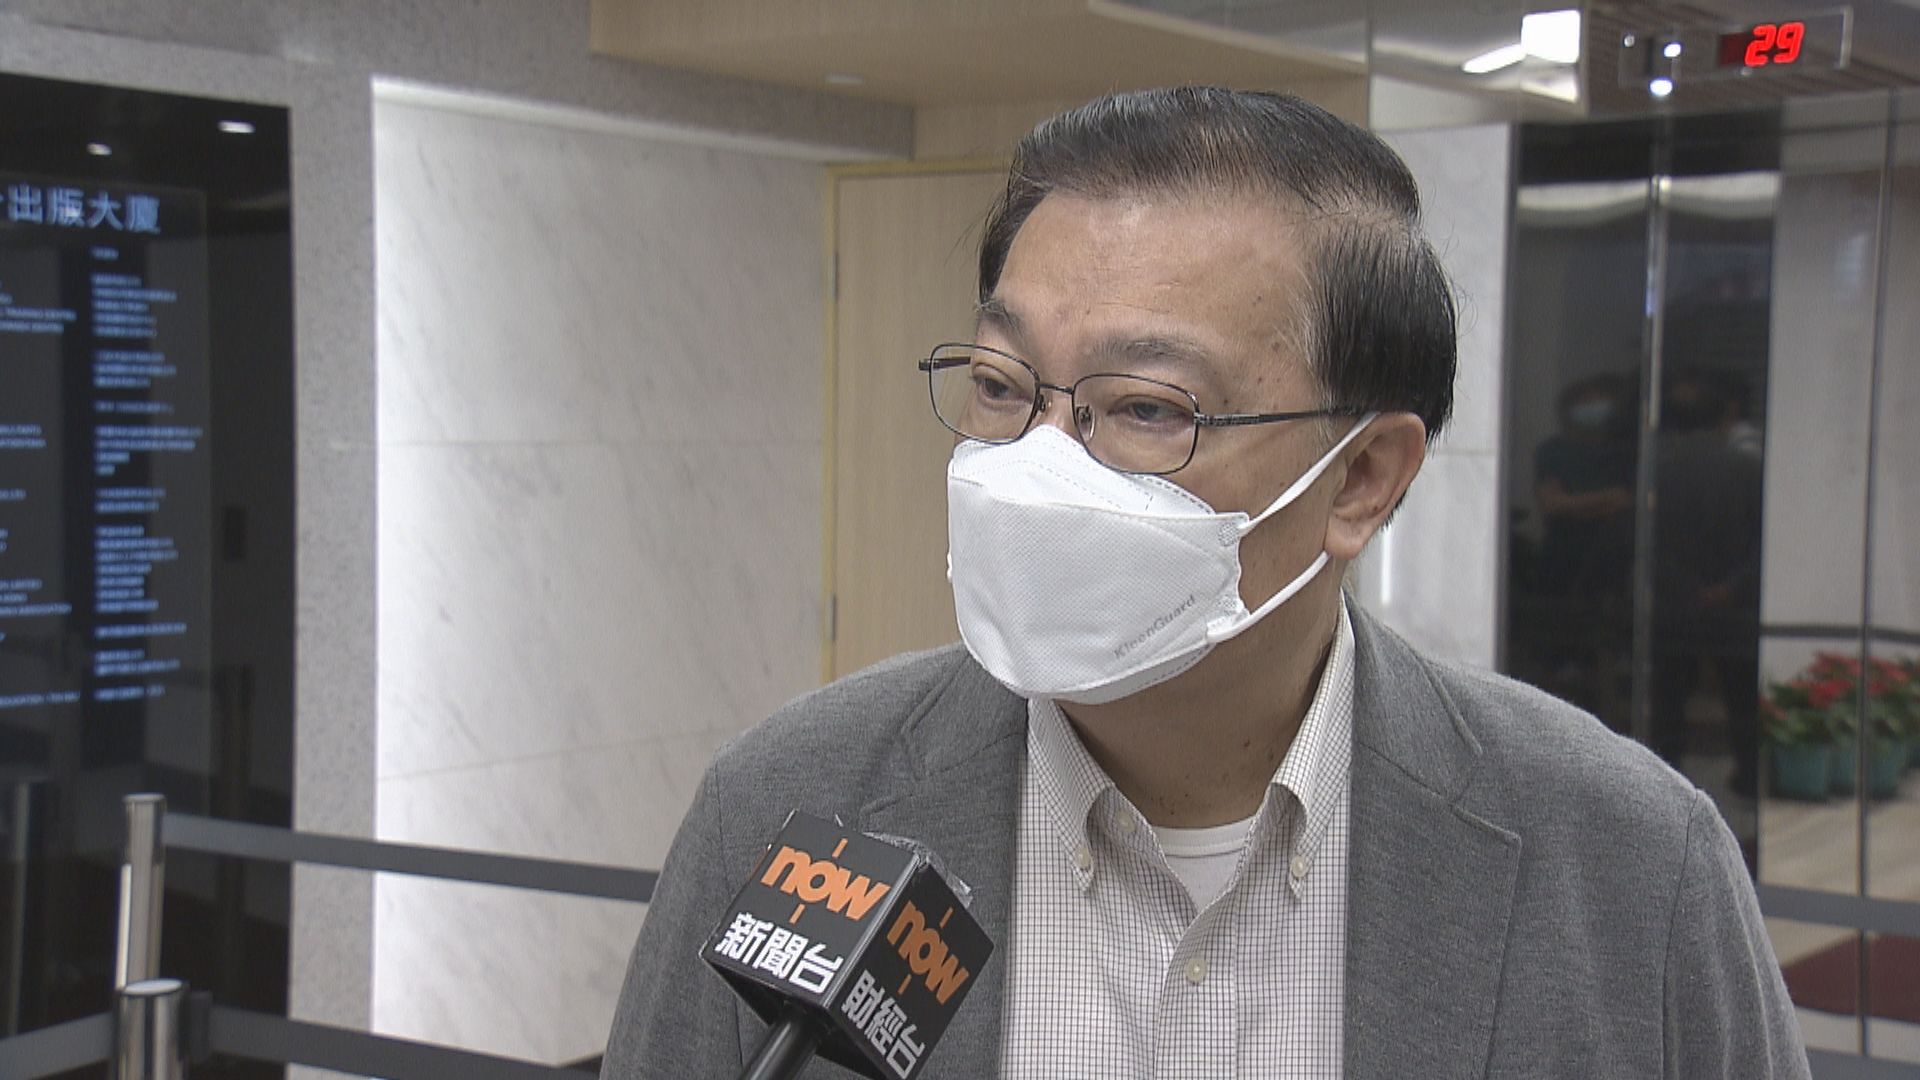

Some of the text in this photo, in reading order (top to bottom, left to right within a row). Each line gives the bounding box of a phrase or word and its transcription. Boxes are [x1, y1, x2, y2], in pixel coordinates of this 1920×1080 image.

[1744, 22, 1805, 67] 29
[1113, 594, 1196, 660] KleenGuard
[760, 845, 892, 921] now
[714, 912, 844, 994] 新聞台
[886, 900, 970, 1005] now
[841, 968, 925, 1080] 財經台
